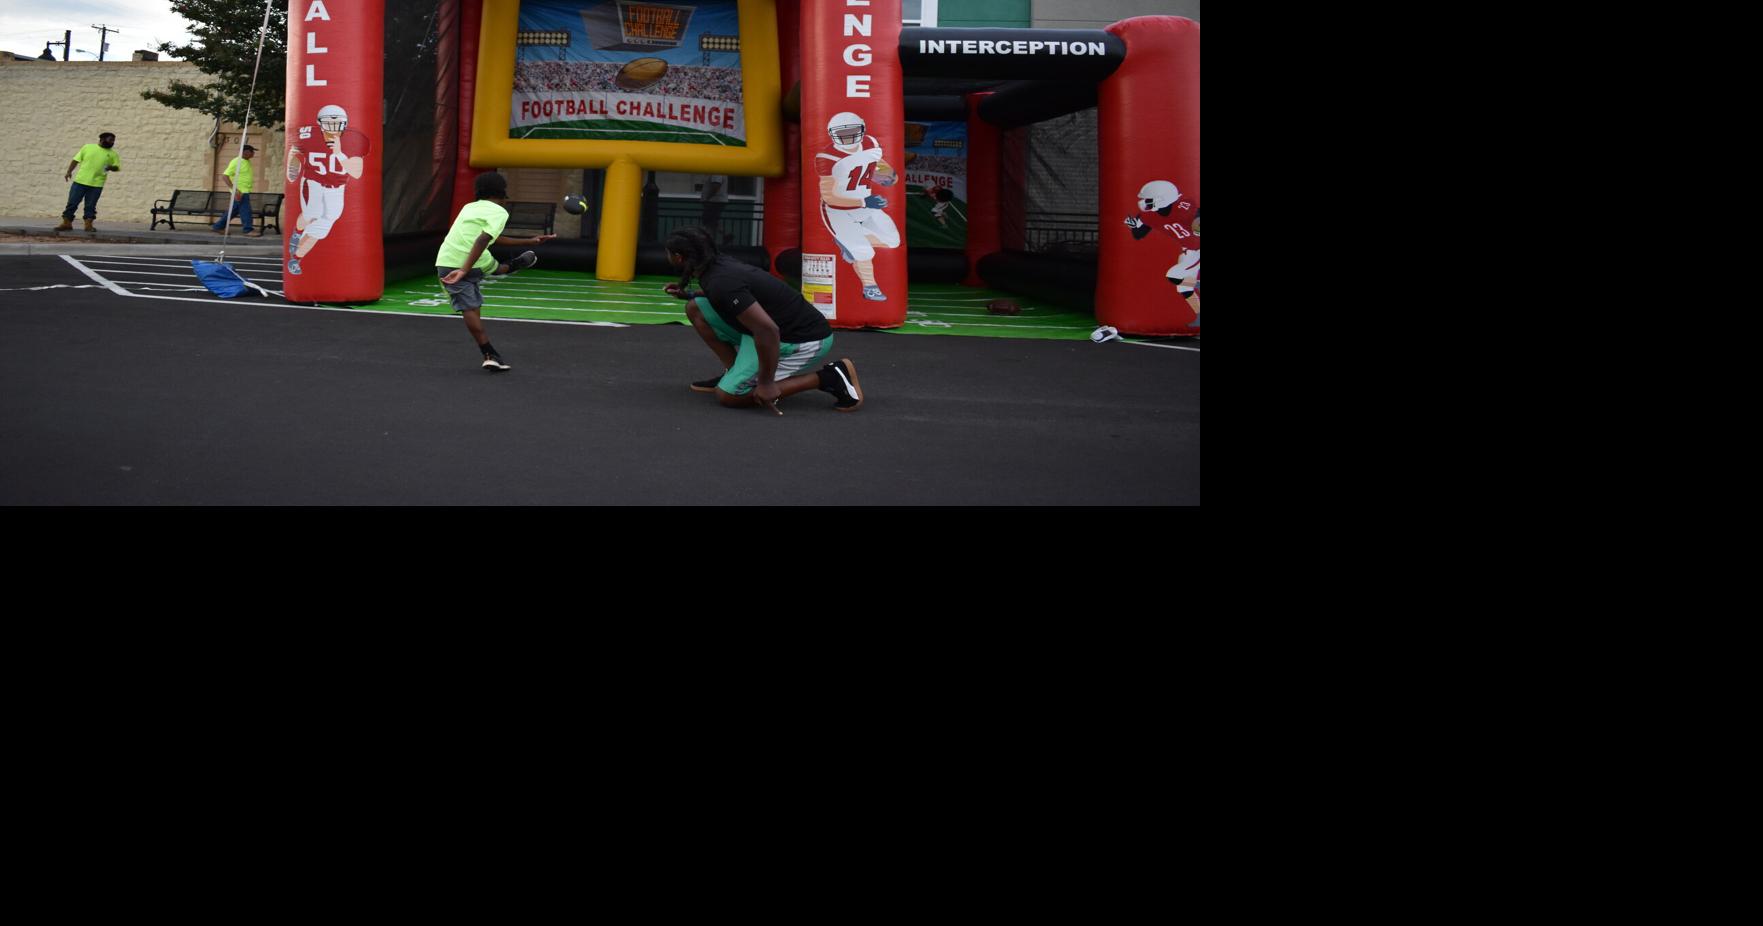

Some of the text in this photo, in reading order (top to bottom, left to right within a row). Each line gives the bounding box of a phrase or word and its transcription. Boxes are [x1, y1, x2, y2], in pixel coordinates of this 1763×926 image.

[843, 0, 873, 98] NGE
[919, 40, 1105, 56] INTERCEPTION
[521, 99, 735, 129] FOOTBALL CHALLENGE
[846, 161, 878, 191] 14
[1163, 223, 1191, 239] 23
